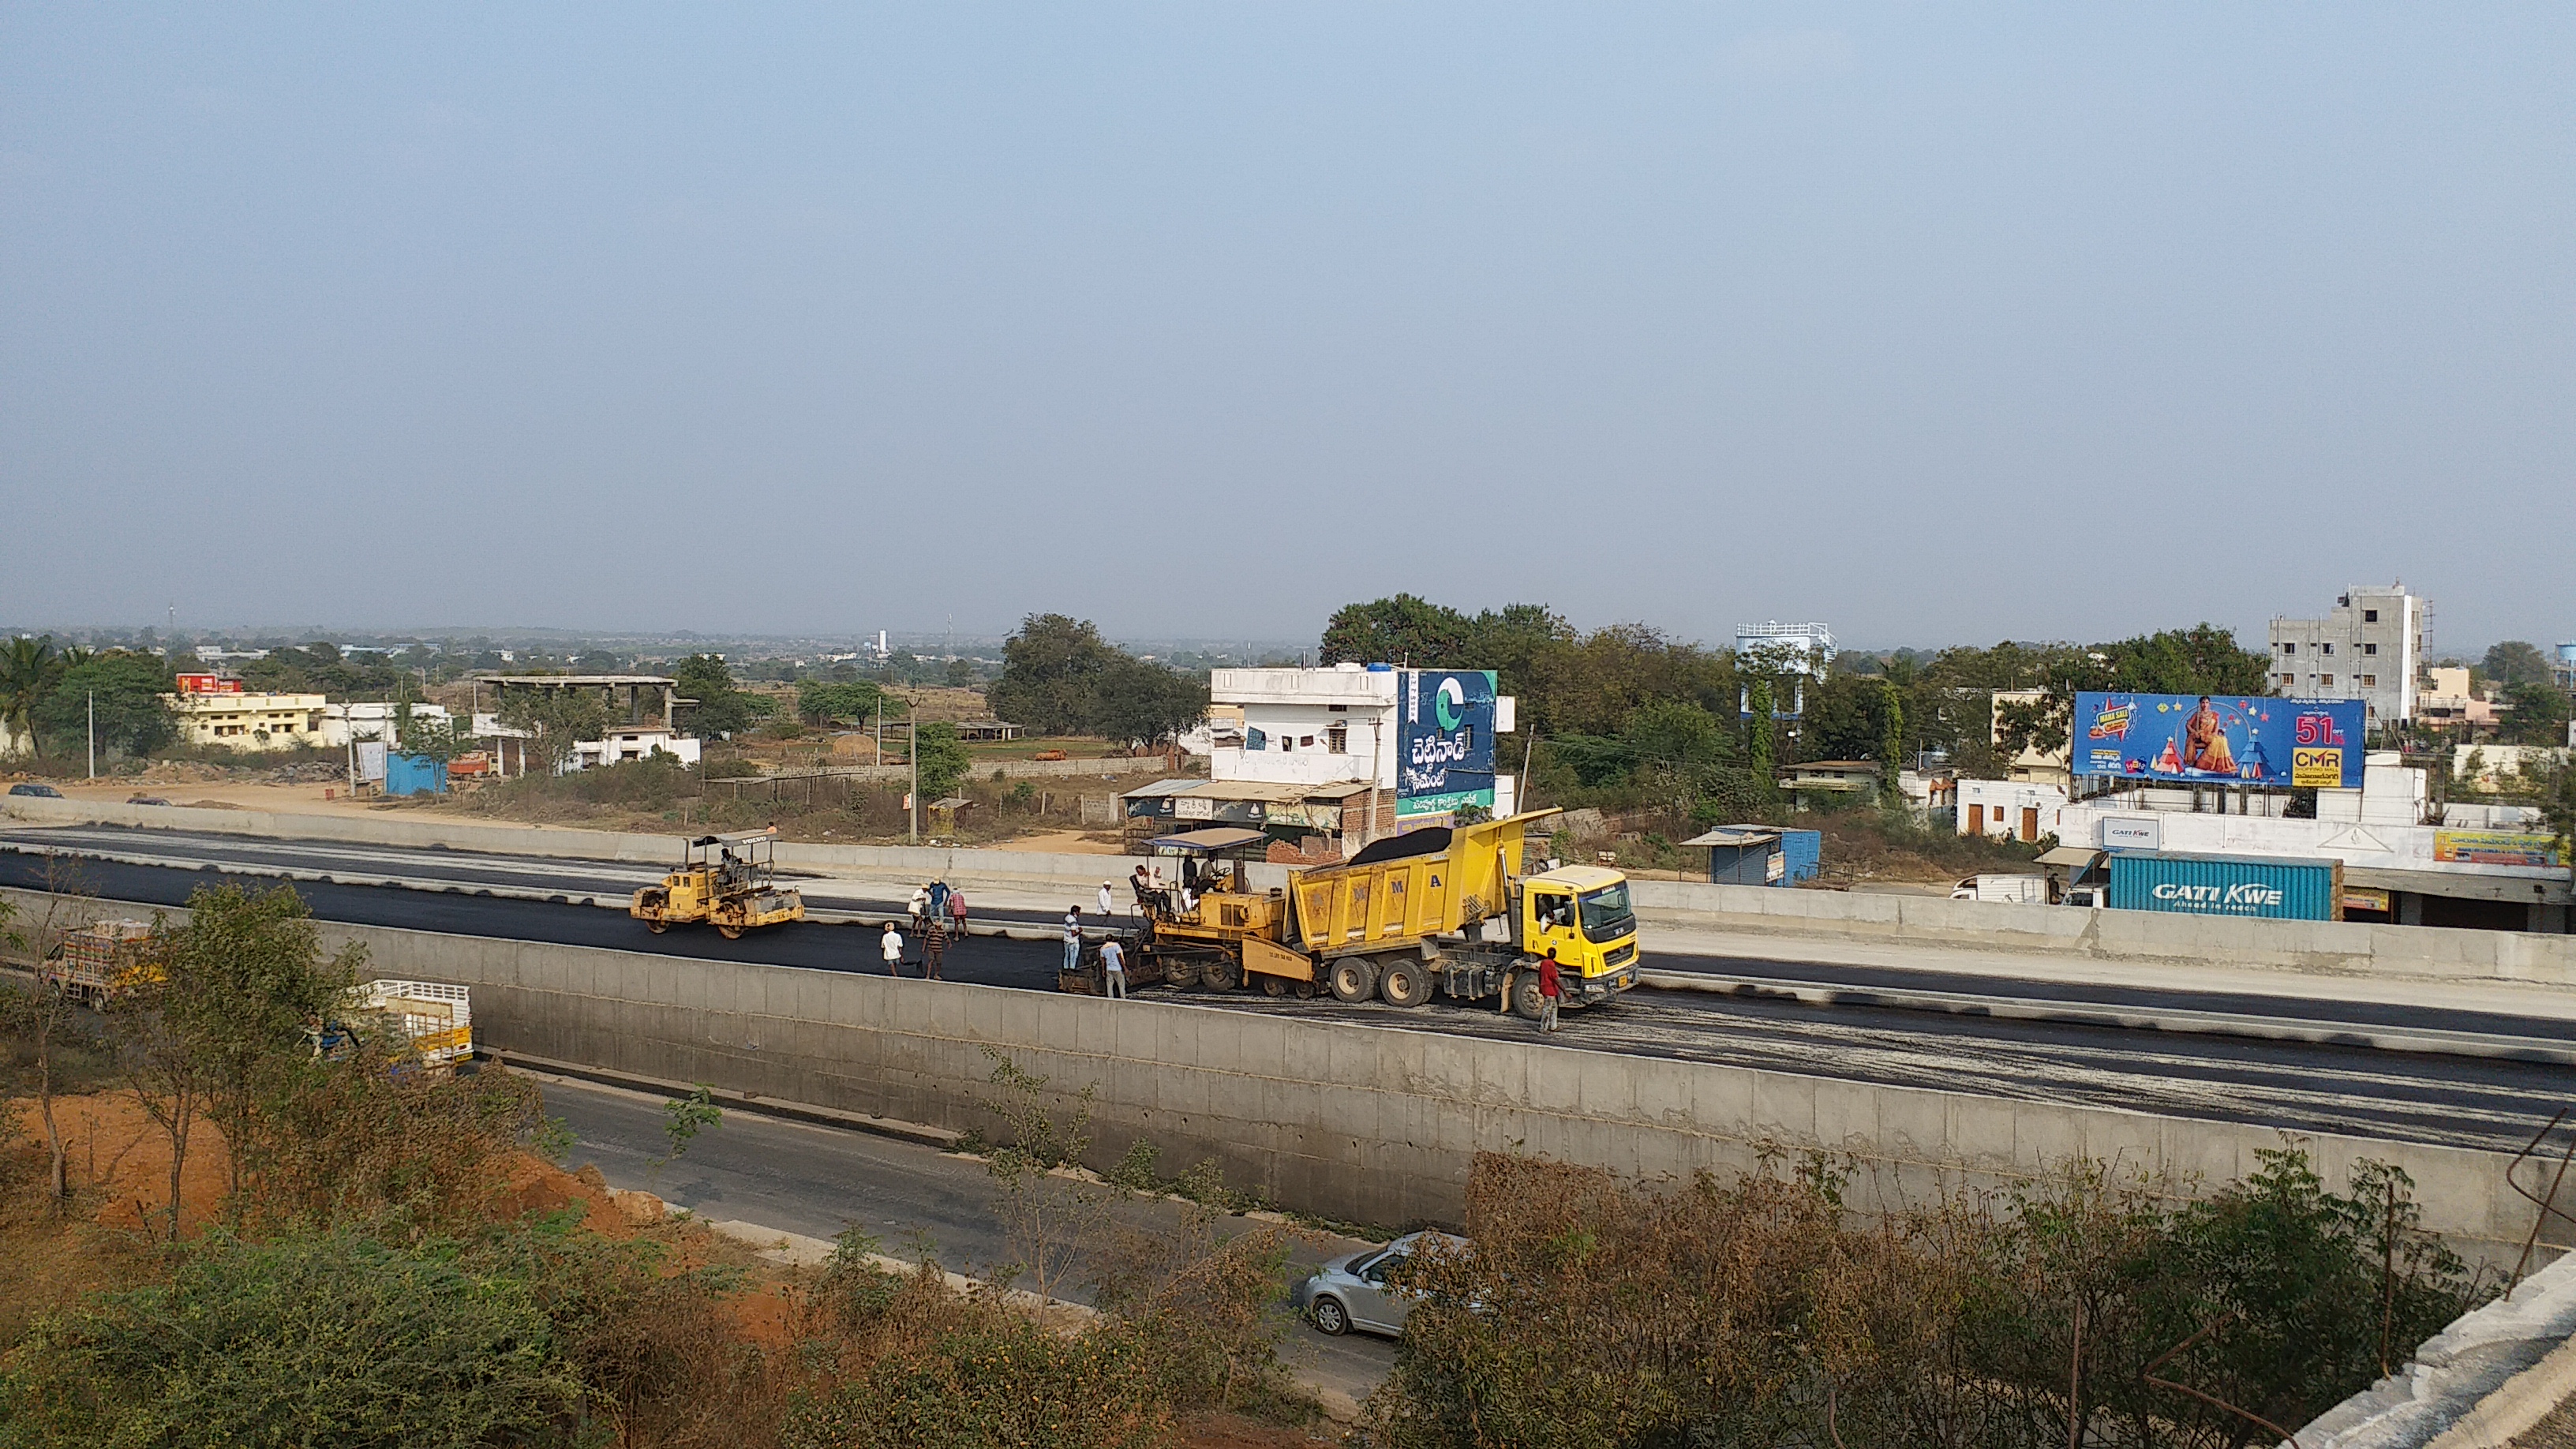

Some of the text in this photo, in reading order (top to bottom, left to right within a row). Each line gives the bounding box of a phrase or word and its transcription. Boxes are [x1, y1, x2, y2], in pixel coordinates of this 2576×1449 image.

[2295, 716, 2333, 745] 51
[1411, 732, 1466, 773] చెట్టినాడ్
[2295, 749, 2339, 767] CMR
[742, 836, 767, 844] VOLVO
[2151, 883, 2283, 906] GATI KWE
[2173, 900, 2256, 912] Ahead in reach
